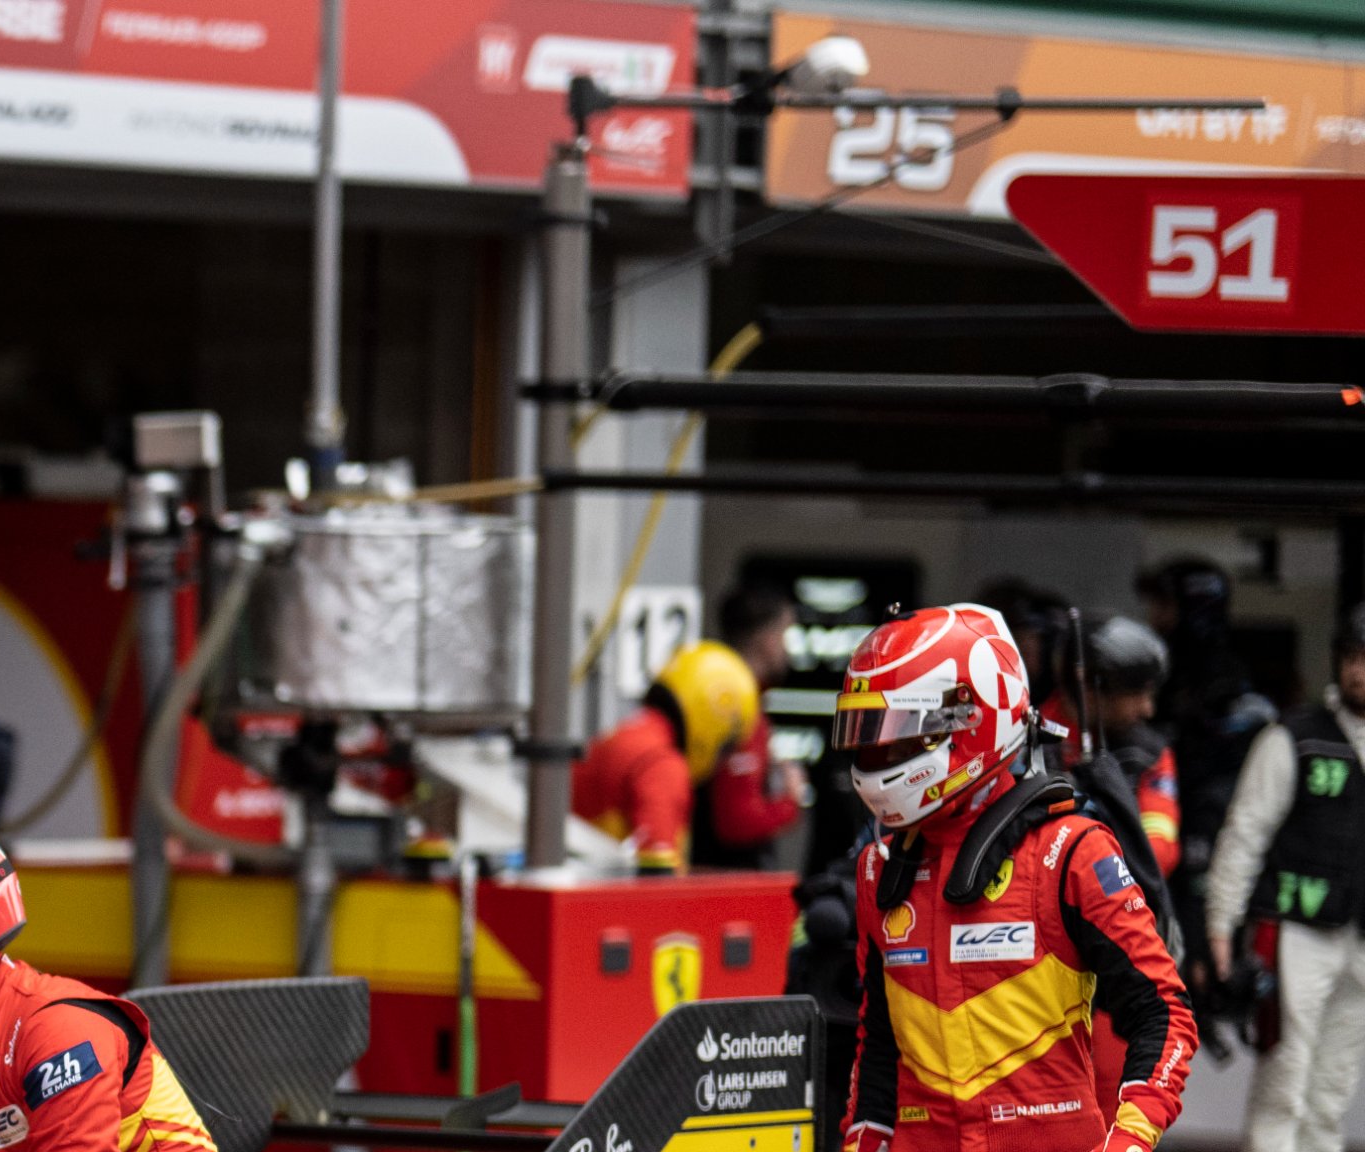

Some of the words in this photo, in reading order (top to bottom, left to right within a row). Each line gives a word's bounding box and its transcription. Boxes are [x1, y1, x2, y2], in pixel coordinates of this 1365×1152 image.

[827, 88, 957, 191] 25
[1147, 205, 1289, 302] 51
[907, 769, 934, 785] BELL
[1043, 825, 1072, 871] Sabelt
[956, 925, 1029, 946] WEC
[720, 1030, 805, 1061] Santander
[38, 1051, 82, 1090] 24h
[717, 1072, 744, 1091] LARS
[745, 1070, 787, 1089] LARSEN
[41, 1086, 55, 1099] LE
[54, 1073, 82, 1094] MANS
[717, 1091, 751, 1110] GROUP
